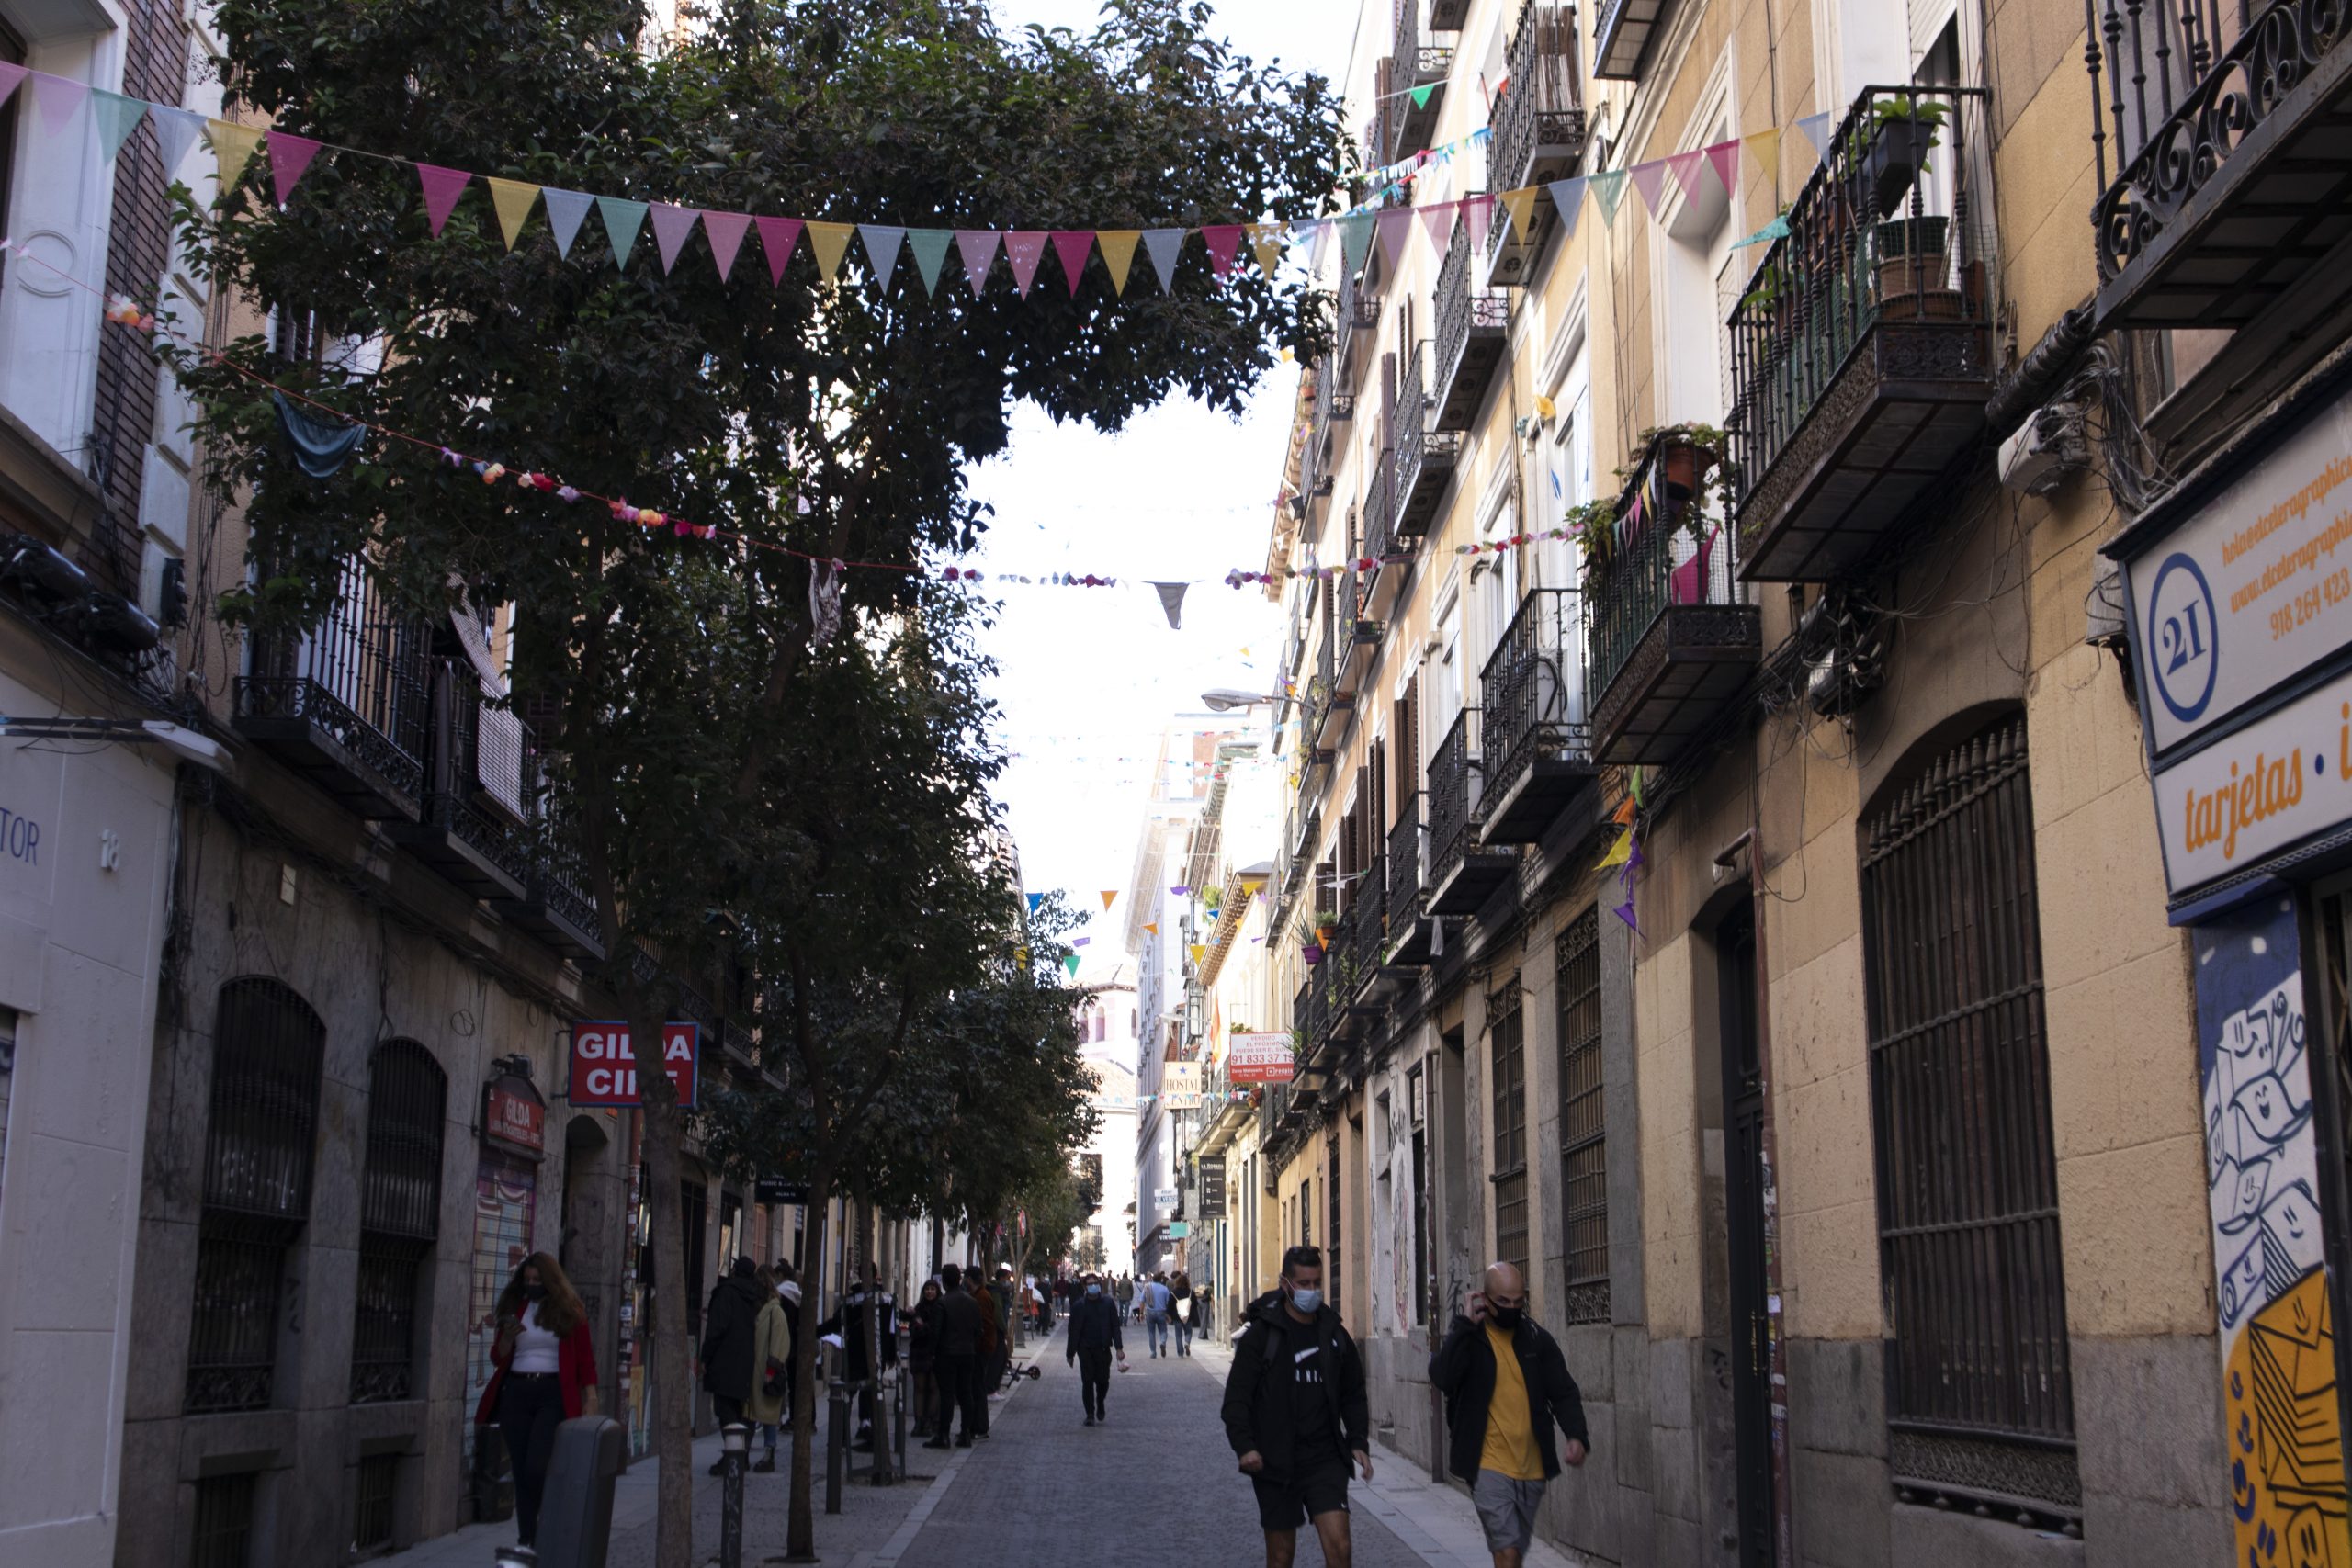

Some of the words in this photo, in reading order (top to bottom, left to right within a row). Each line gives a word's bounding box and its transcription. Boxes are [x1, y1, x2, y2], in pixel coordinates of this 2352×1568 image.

[2270, 603, 2293, 641] 918
[2295, 583, 2321, 627] 264
[2324, 567, 2350, 608] 423
[2163, 599, 2207, 676] 21
[2186, 748, 2303, 861] tarjetas
[577, 1032, 692, 1061] GILA
[1232, 1055, 1243, 1065] 91
[1247, 1054, 1264, 1064] 833
[1267, 1054, 1280, 1064] 37
[586, 1068, 678, 1095] CI
[1165, 1078, 1200, 1091] HOSTAL
[506, 1098, 530, 1128] GILDA
